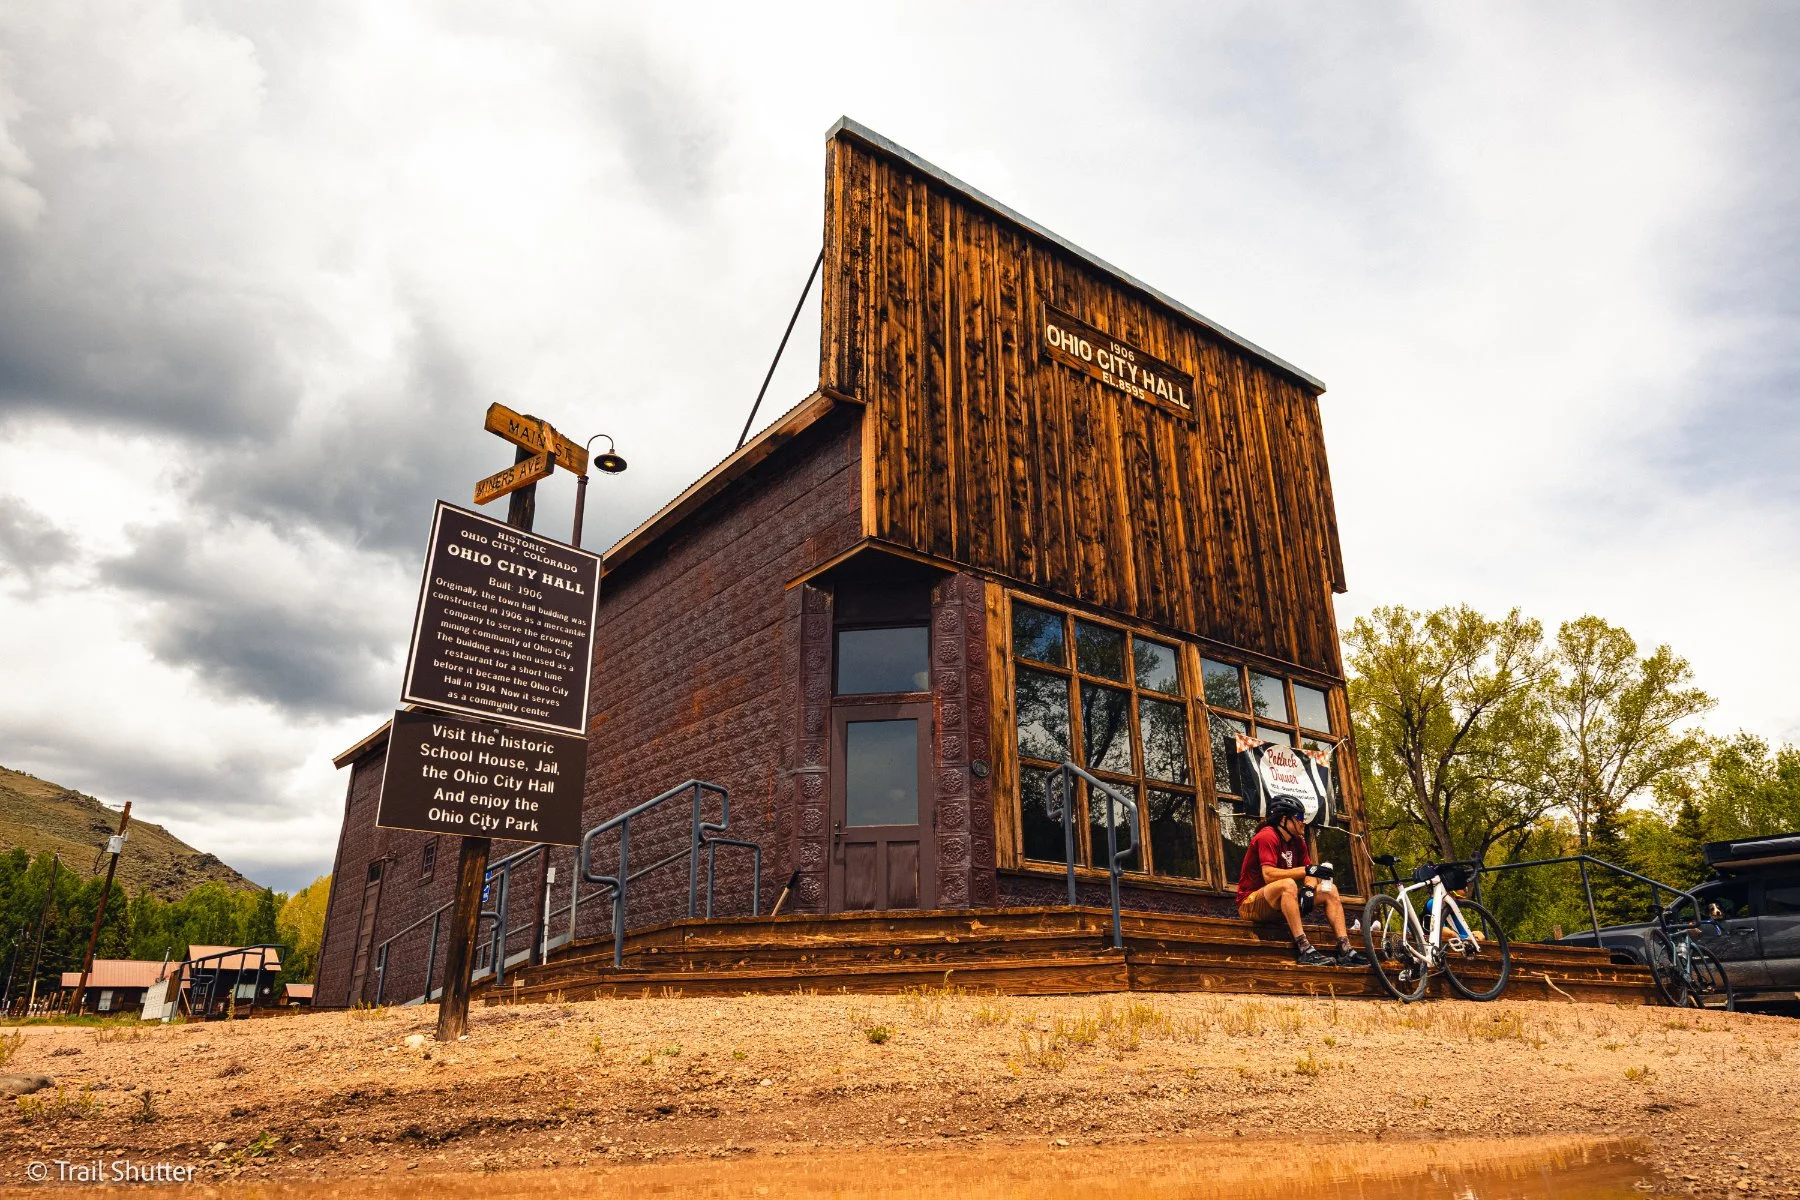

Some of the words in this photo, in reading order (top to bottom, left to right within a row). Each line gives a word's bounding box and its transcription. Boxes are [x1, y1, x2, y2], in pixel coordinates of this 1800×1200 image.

[1111, 342, 1134, 361] 1906
[1047, 325, 1092, 361] OHIO
[1097, 349, 1137, 383] CITY
[1143, 369, 1190, 409] HALL
[508, 420, 545, 449] MAIN
[476, 469, 514, 497] MINERS
[519, 456, 543, 478] AVE.
[461, 530, 487, 544] OHIO
[524, 552, 577, 572] COLORADO
[498, 532, 546, 553] HISTORIC
[448, 544, 491, 565] OHIO
[498, 560, 537, 579] CITY
[542, 573, 584, 594] HALL
[489, 577, 513, 591] Built:
[519, 586, 542, 600] 1906
[433, 591, 487, 611] constructed
[501, 609, 522, 620] 1906
[482, 591, 495, 600] the
[499, 595, 519, 607] town
[522, 602, 535, 611] hall
[539, 607, 568, 622] building
[572, 618, 586, 626] was
[441, 620, 470, 634] mining
[473, 630, 519, 647] community
[534, 643, 552, 654] Ohio
[555, 649, 571, 660] City
[444, 608, 483, 624] company
[498, 622, 522, 633] serve
[525, 629, 538, 637] the
[541, 633, 572, 648] growing
[437, 632, 453, 643] The
[457, 637, 490, 652] building
[494, 648, 509, 656] was
[513, 651, 531, 661] then
[534, 657, 554, 667] used
[434, 659, 463, 672] before
[476, 669, 510, 682] became
[514, 677, 528, 686] the
[530, 681, 550, 692] Ohio
[552, 686, 568, 696] City
[445, 649, 492, 665] restaurant
[496, 660, 508, 669] for
[519, 665, 541, 676] short
[544, 672, 562, 681] time
[444, 675, 460, 686] Hall
[501, 688, 520, 698] Now
[532, 695, 560, 706] serves
[470, 695, 518, 712] community
[521, 706, 550, 718] center.
[432, 724, 466, 740] Visit
[471, 731, 495, 745] the
[501, 735, 554, 754] historic
[420, 744, 472, 762] School
[479, 752, 528, 771] House,
[535, 760, 560, 775] Jail,
[1267, 749, 1297, 768] Potluck
[422, 765, 448, 780] the
[454, 769, 488, 784] Ohio
[494, 775, 523, 791] City
[528, 779, 554, 793] Hall
[1270, 767, 1298, 784] Dinner
[434, 788, 464, 803] And
[470, 794, 509, 810] enjoy
[515, 798, 539, 811] the
[428, 808, 463, 824] Ohio
[470, 813, 499, 830] City
[506, 816, 538, 832] Park
